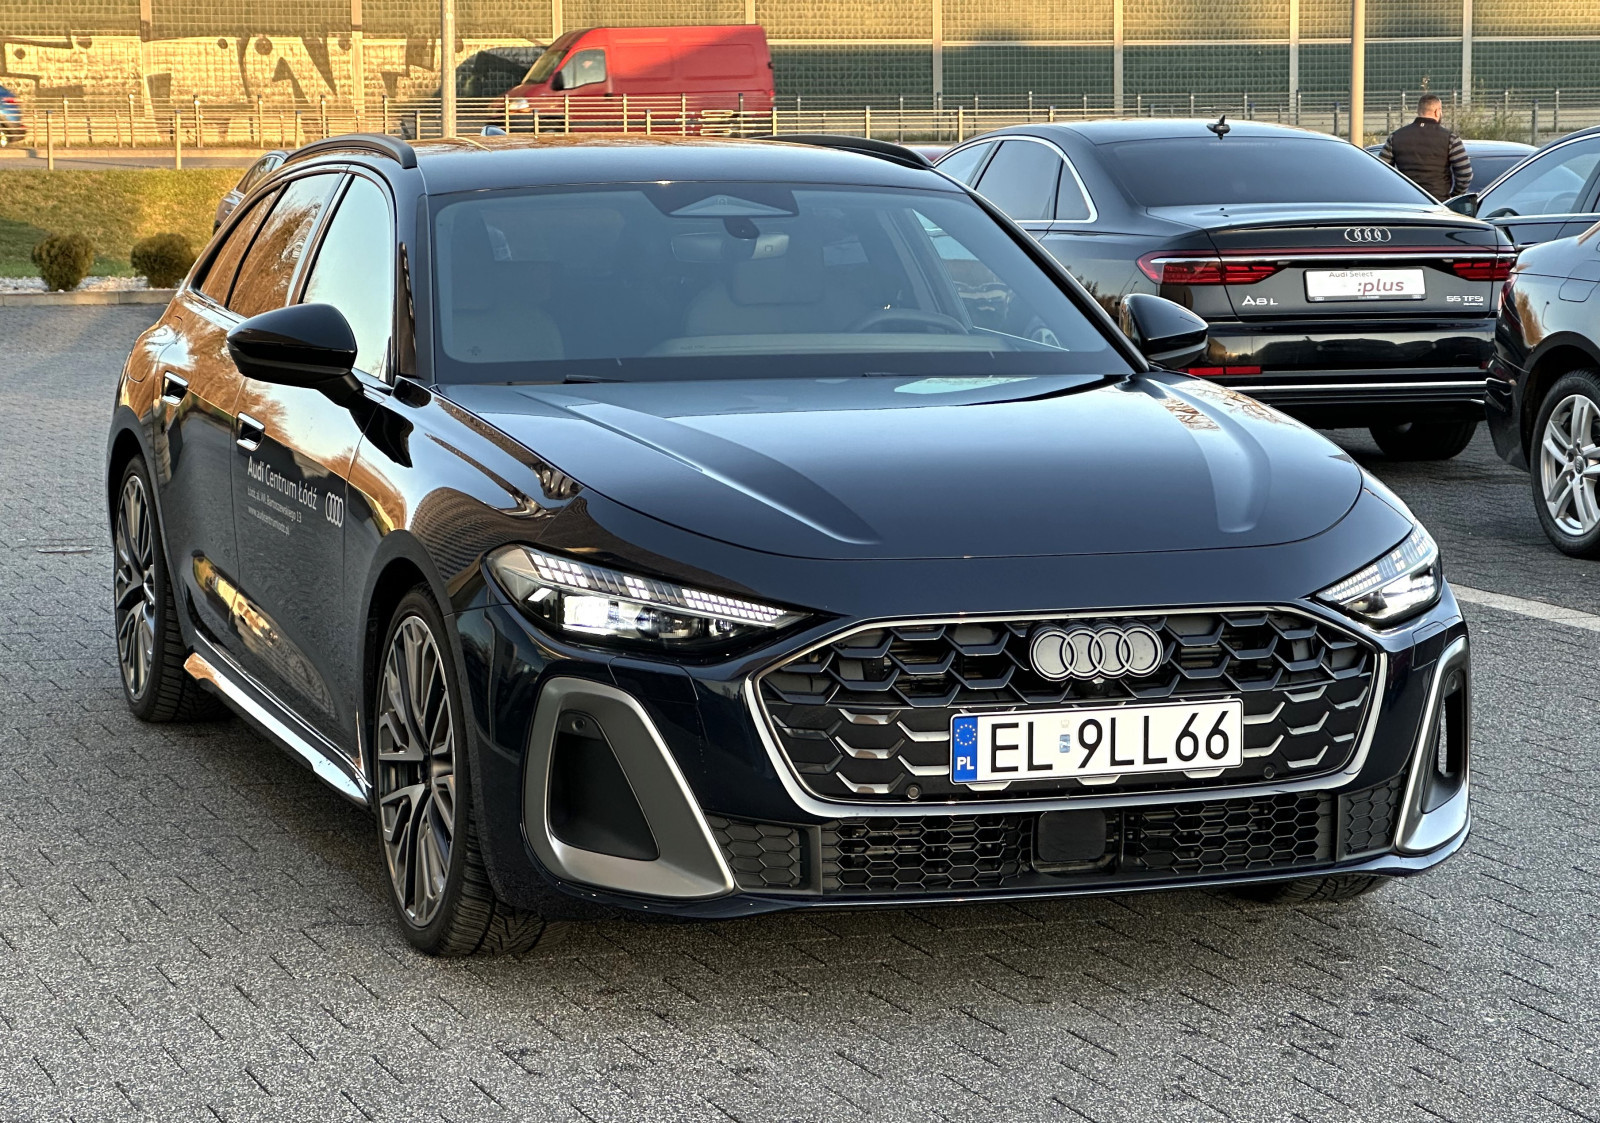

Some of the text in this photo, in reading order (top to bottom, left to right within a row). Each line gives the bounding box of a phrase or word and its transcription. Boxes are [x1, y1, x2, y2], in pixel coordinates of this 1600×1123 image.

[1358, 278, 1404, 296] :plus
[1446, 295, 1462, 303] 55
[247, 456, 317, 510] Audi Centrum Łódź
[296, 511, 302, 523] 13
[990, 710, 1230, 773] EL 9LL66
[956, 756, 975, 770] PL
